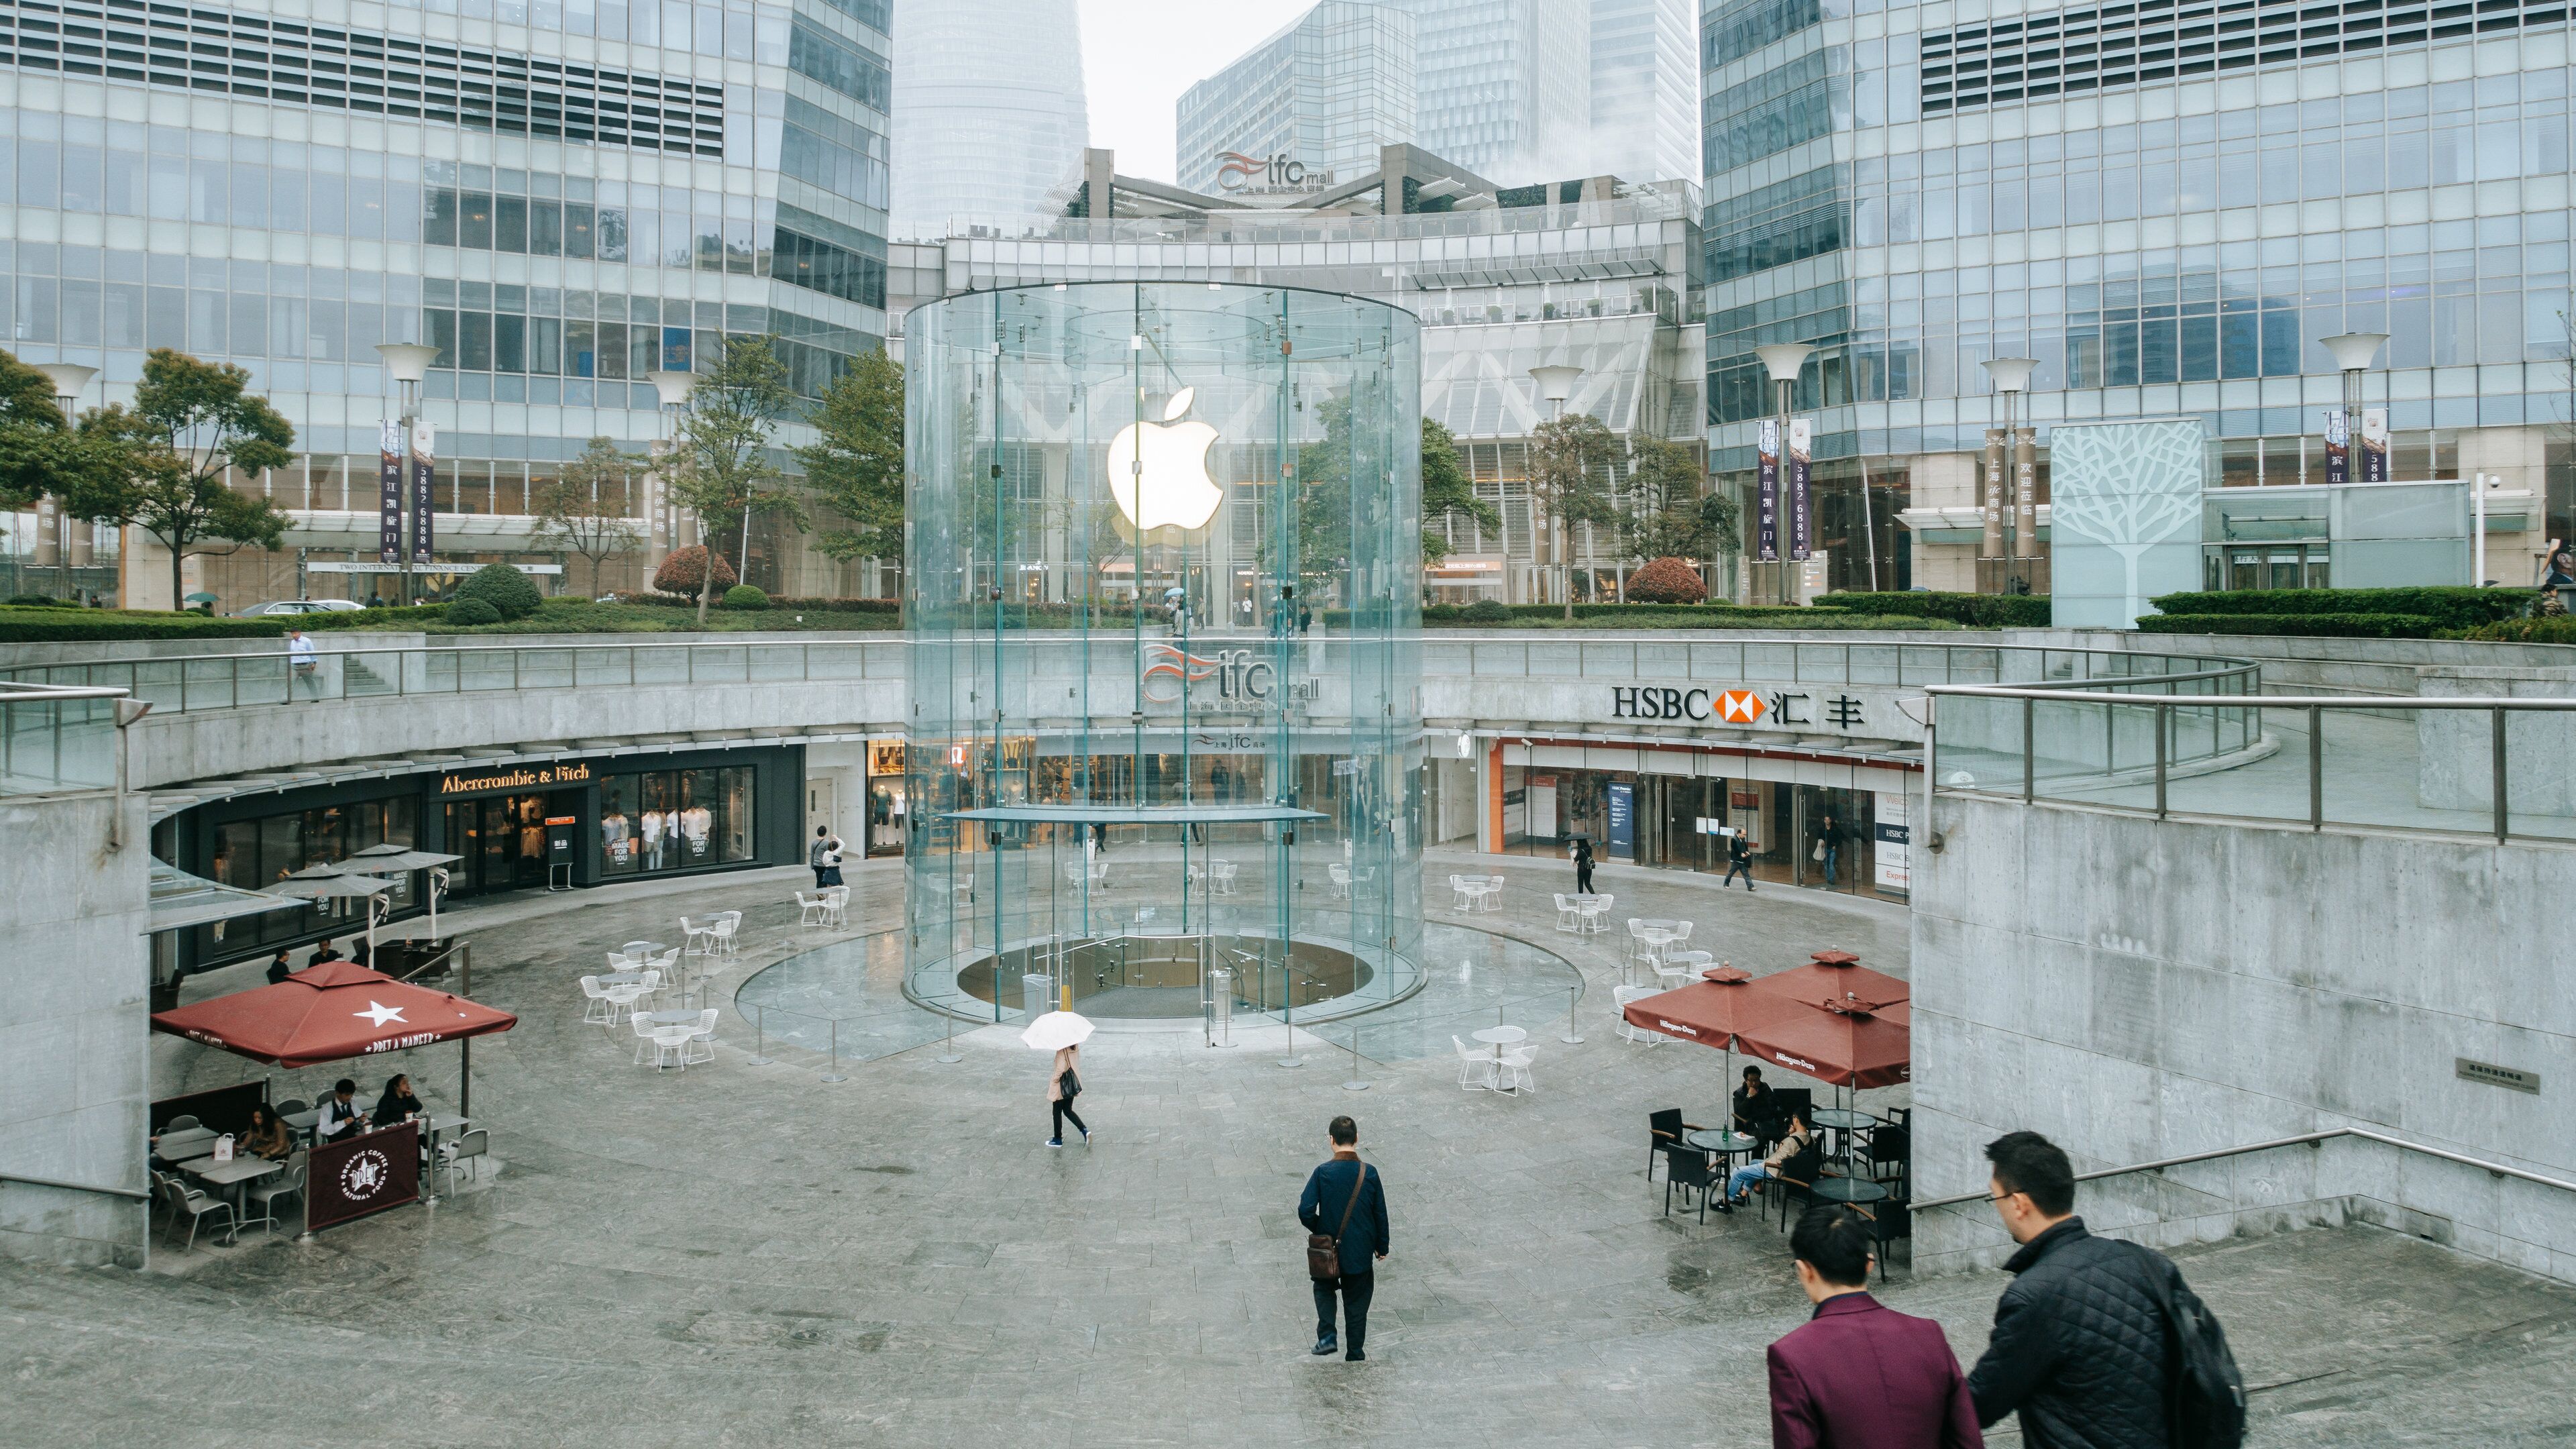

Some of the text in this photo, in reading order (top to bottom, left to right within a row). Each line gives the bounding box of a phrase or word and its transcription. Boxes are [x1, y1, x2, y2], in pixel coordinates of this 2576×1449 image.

[1268, 154, 1334, 185] ifc mall
[2331, 455, 2343, 482] 滨江
[655, 472, 666, 532] 海ifc商场
[1988, 458, 2000, 522] 上海ifc商场
[2020, 462, 2032, 515] 欢迎莅临
[386, 465, 397, 543] 滨江凯旋门
[1763, 465, 1773, 541] 滨江凯旋门
[1218, 650, 1276, 700] ifc
[1611, 686, 1710, 720] HSBC
[1769, 691, 1866, 729] 汇丰
[1228, 733, 1251, 751] ifc
[441, 763, 590, 794] Abercrombie & Fitch
[612, 841, 630, 849] MADE
[1886, 829, 1904, 839] HSBC
[1886, 852, 1904, 861] HSBC
[393, 871, 408, 880] MADE
[317, 896, 329, 904] FOR
[395, 885, 406, 894] YOU
[317, 903, 329, 912] YOU
[372, 1032, 434, 1053] PRET A MANGER
[341, 1149, 388, 1179] ORGANIC COFFEE
[352, 1163, 377, 1188] PRET
[342, 1175, 386, 1200] NATURAL FOOD
